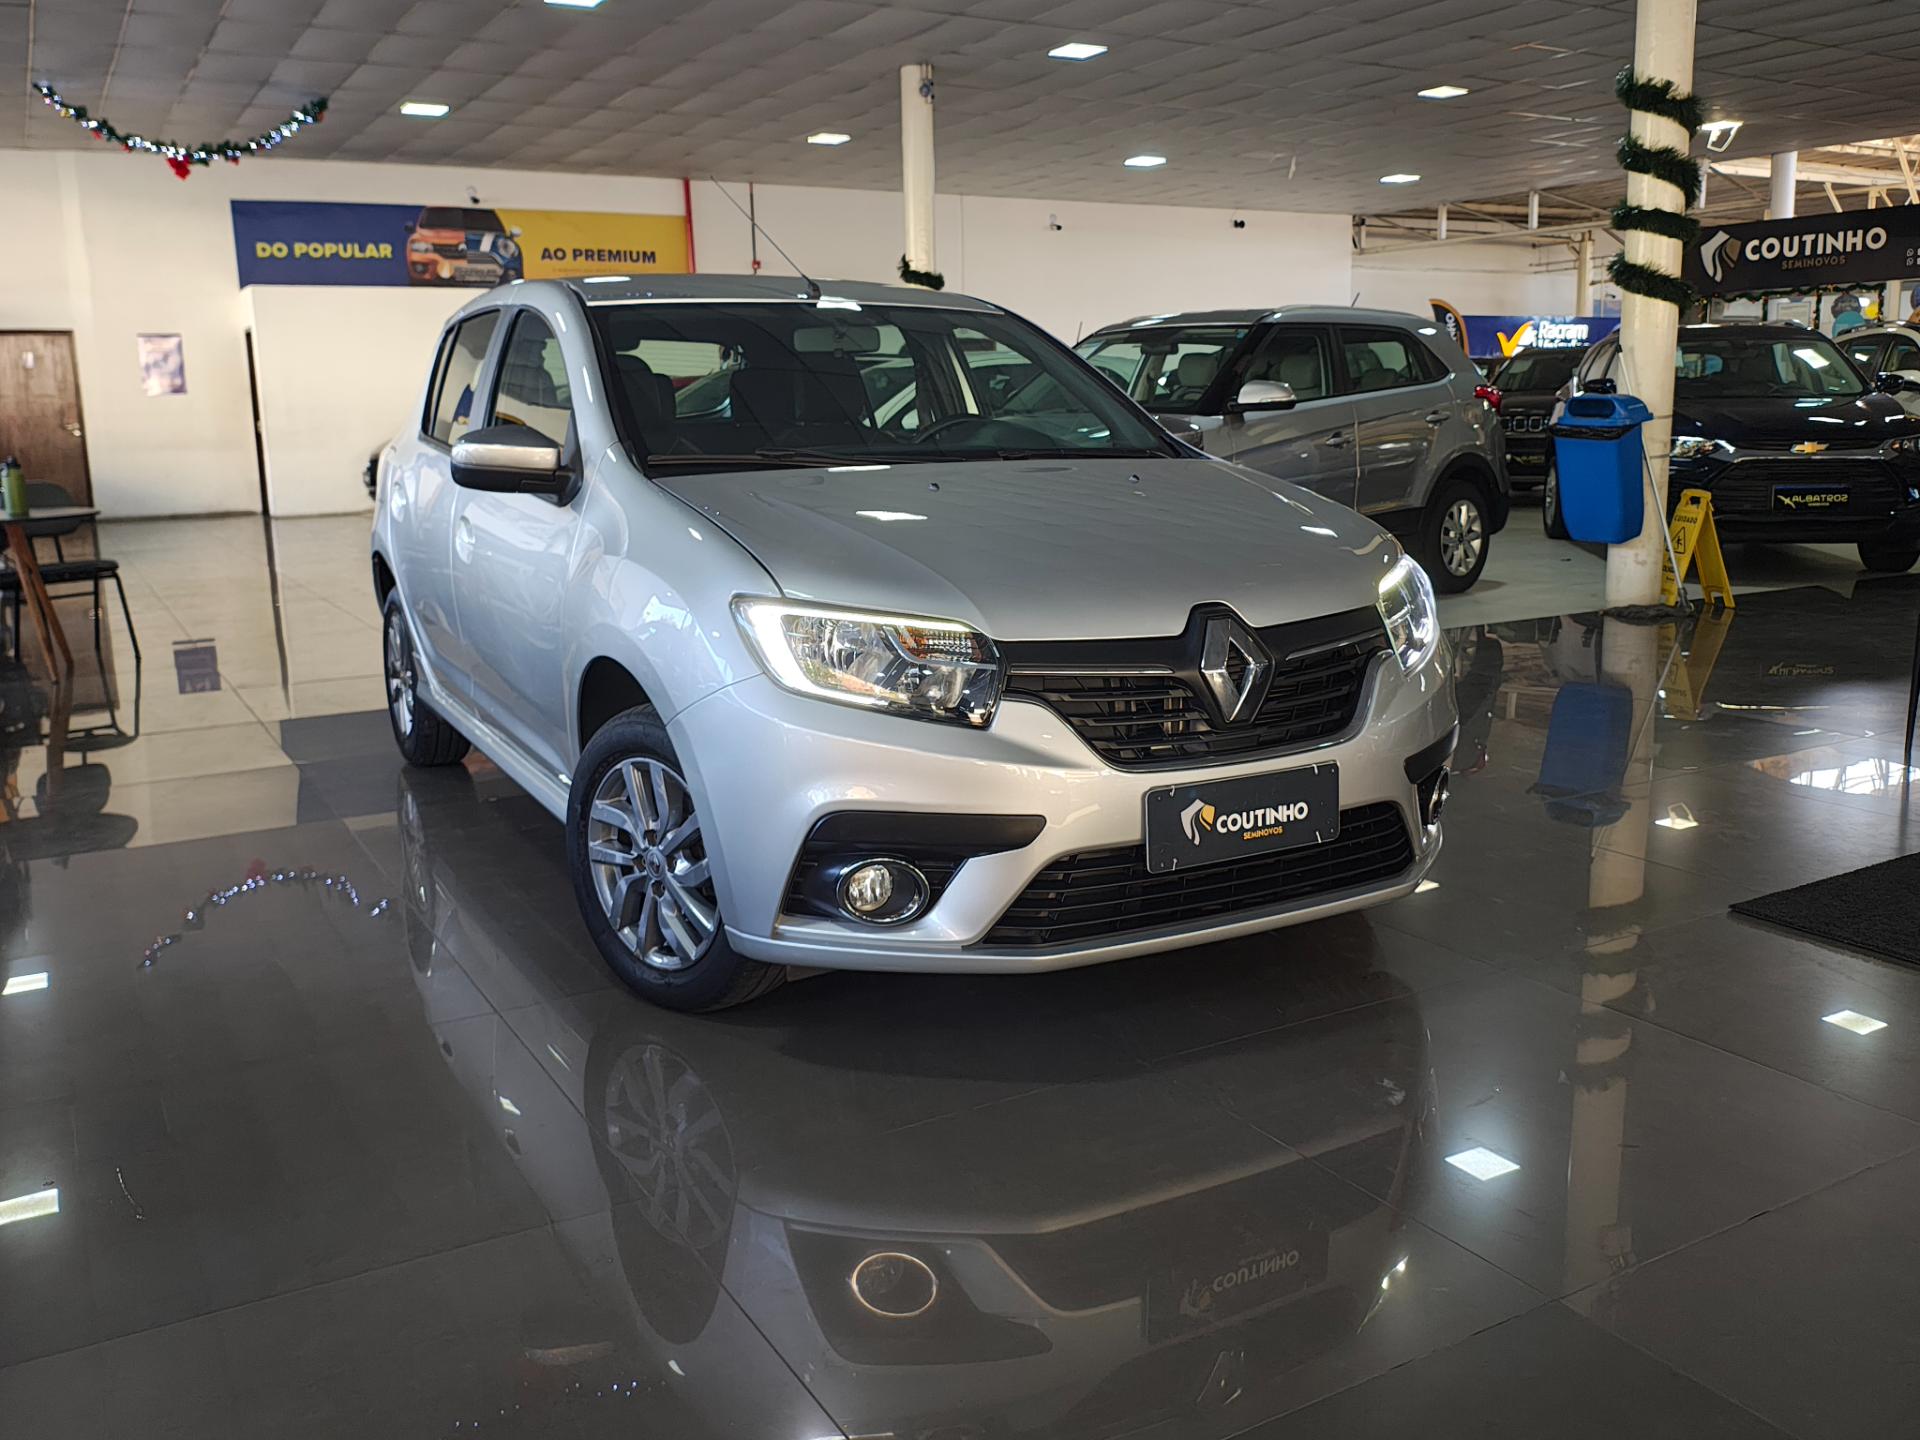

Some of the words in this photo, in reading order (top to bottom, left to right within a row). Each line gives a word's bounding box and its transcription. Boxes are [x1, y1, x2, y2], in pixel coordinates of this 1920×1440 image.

[256, 242, 288, 258] DO
[294, 242, 392, 258] POPULAR
[1745, 227, 1887, 262] COUTINHO
[541, 247, 567, 261] AO
[572, 248, 657, 264] PREMIUM
[1781, 255, 1846, 270] SEMINOVOS
[1216, 801, 1309, 834] COUTINHO
[1243, 825, 1283, 840] SEMINOVOS
